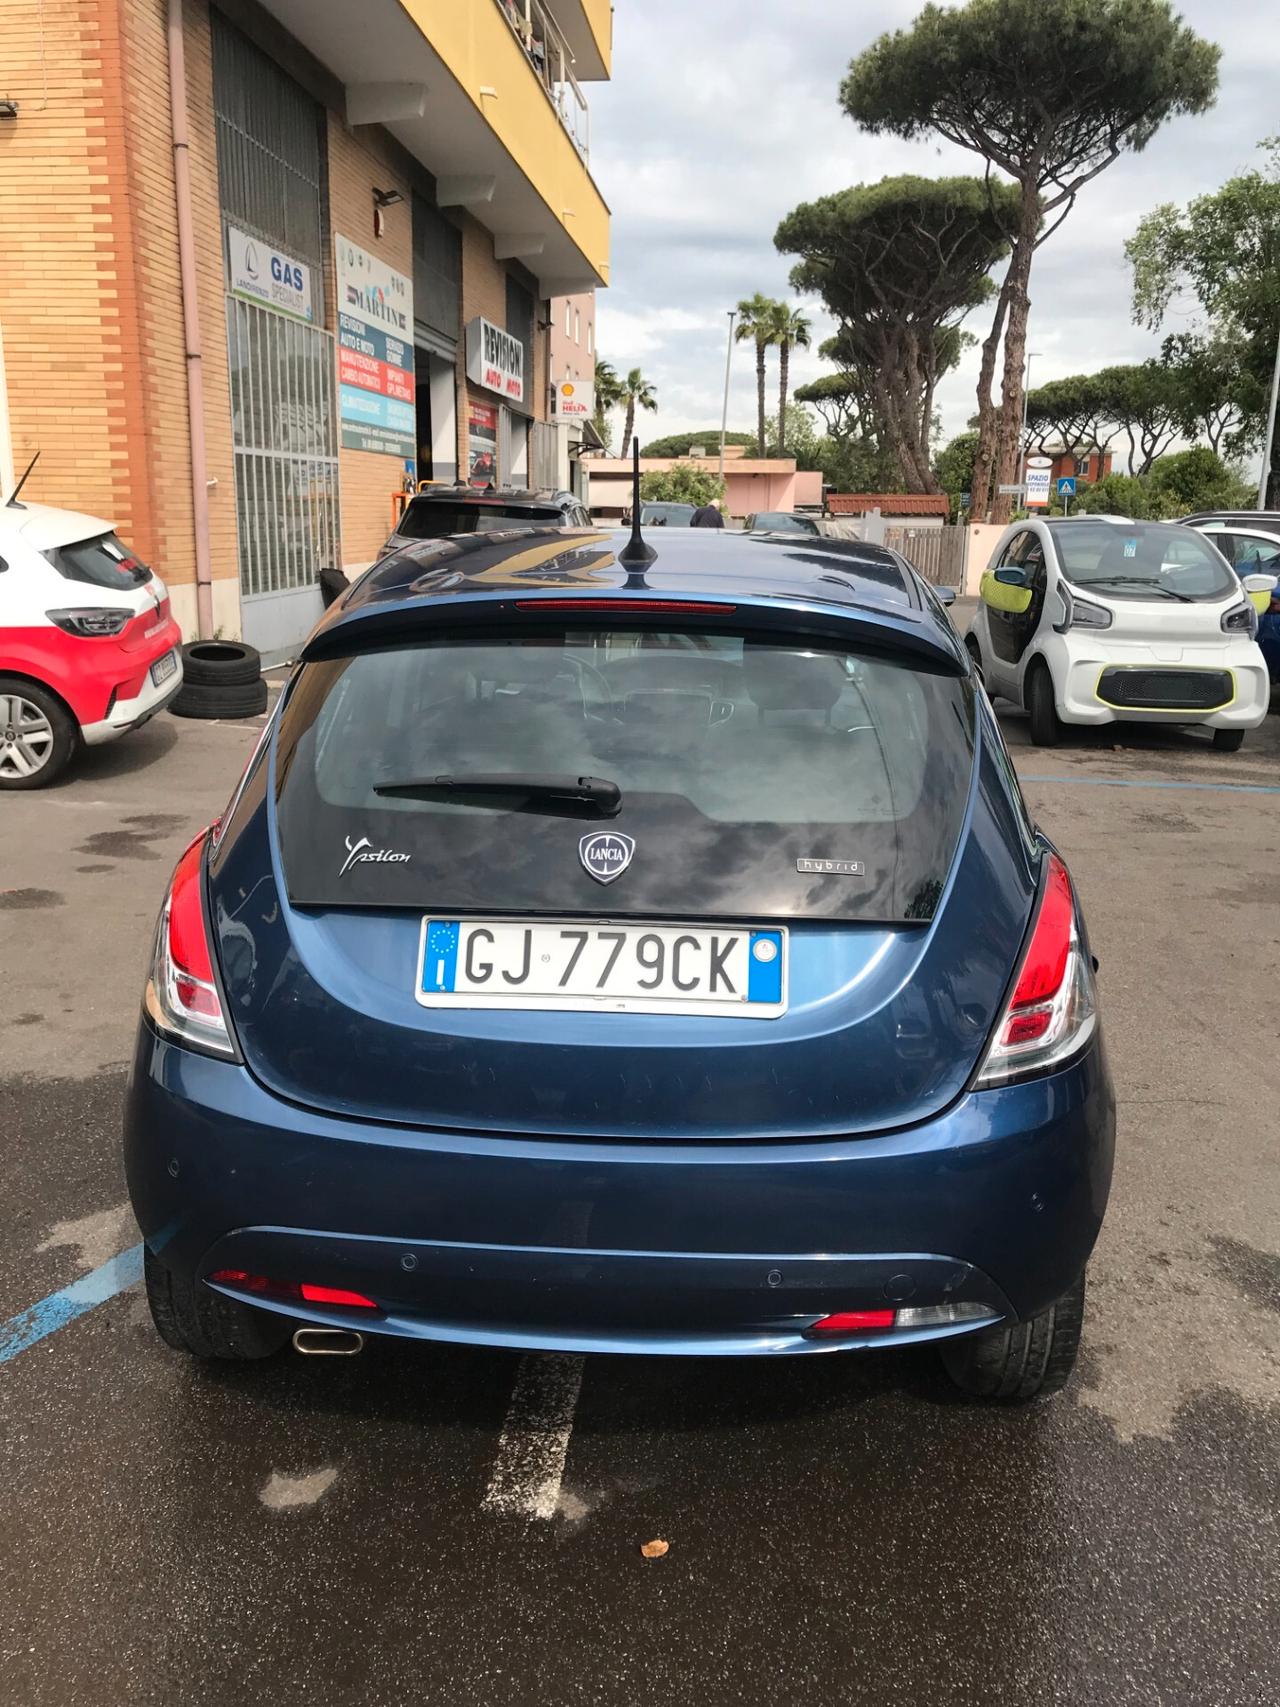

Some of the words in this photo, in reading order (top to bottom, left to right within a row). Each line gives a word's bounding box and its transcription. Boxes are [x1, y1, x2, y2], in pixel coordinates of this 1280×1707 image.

[271, 256, 303, 291] GAS
[340, 331, 356, 349] AUTO
[485, 368, 502, 389] AUTO
[505, 378, 521, 397] MOTO
[1028, 474, 1049, 482] SPAZIO
[339, 835, 411, 877] Ypsilon
[590, 847, 623, 861] LANCIA
[804, 860, 858, 872] hybrid
